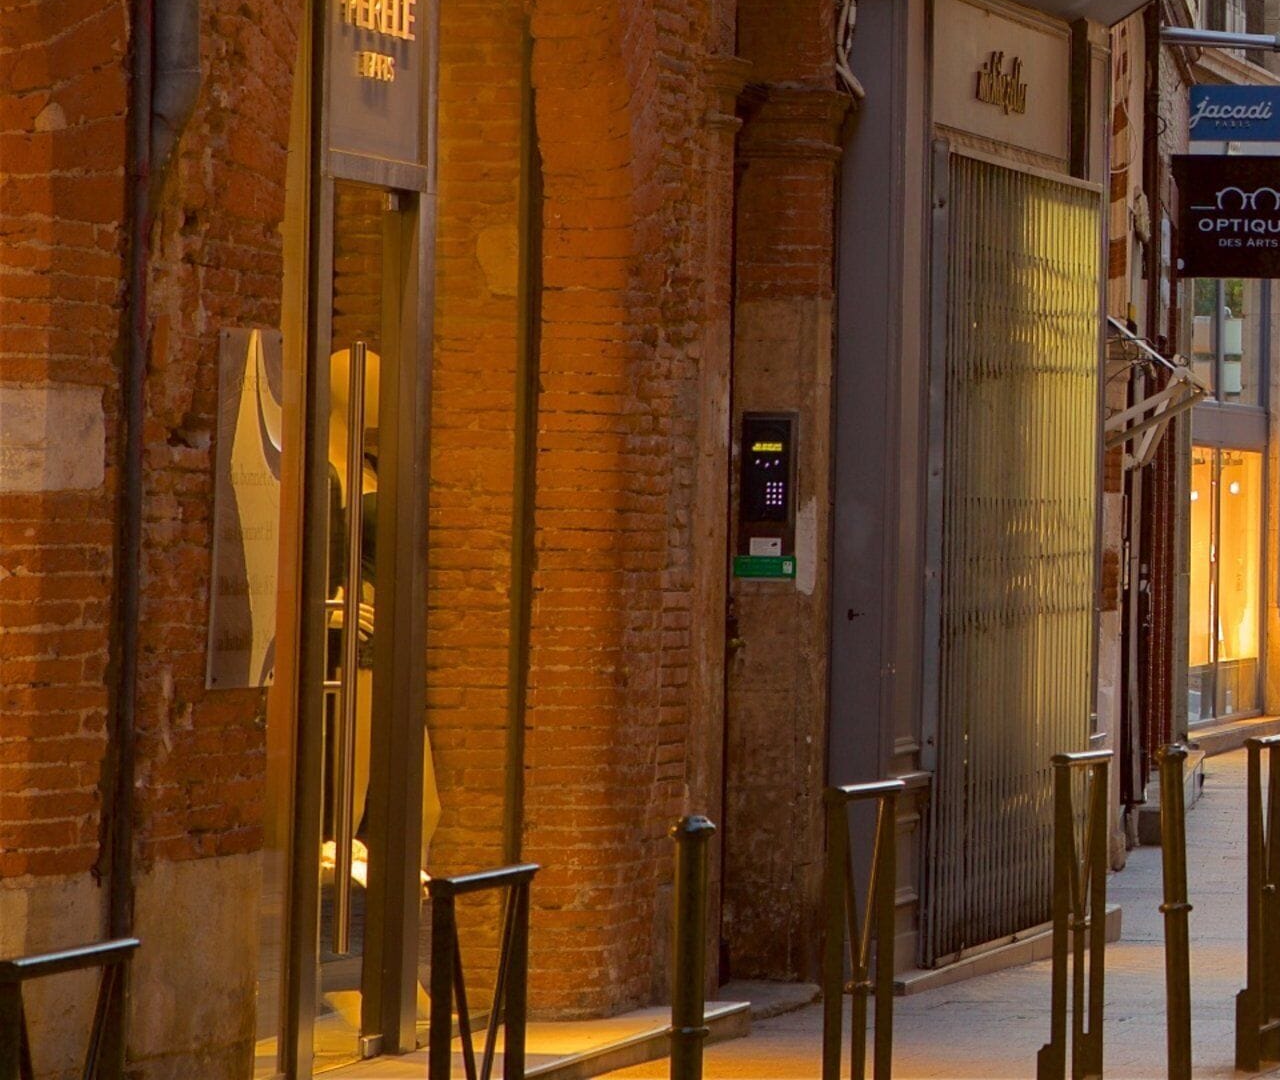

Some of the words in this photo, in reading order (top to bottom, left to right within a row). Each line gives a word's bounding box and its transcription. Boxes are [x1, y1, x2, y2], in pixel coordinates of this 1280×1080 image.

[1189, 95, 1273, 129] jacadi
[1218, 238, 1242, 248] DES
[1246, 237, 1279, 248] ARTS
